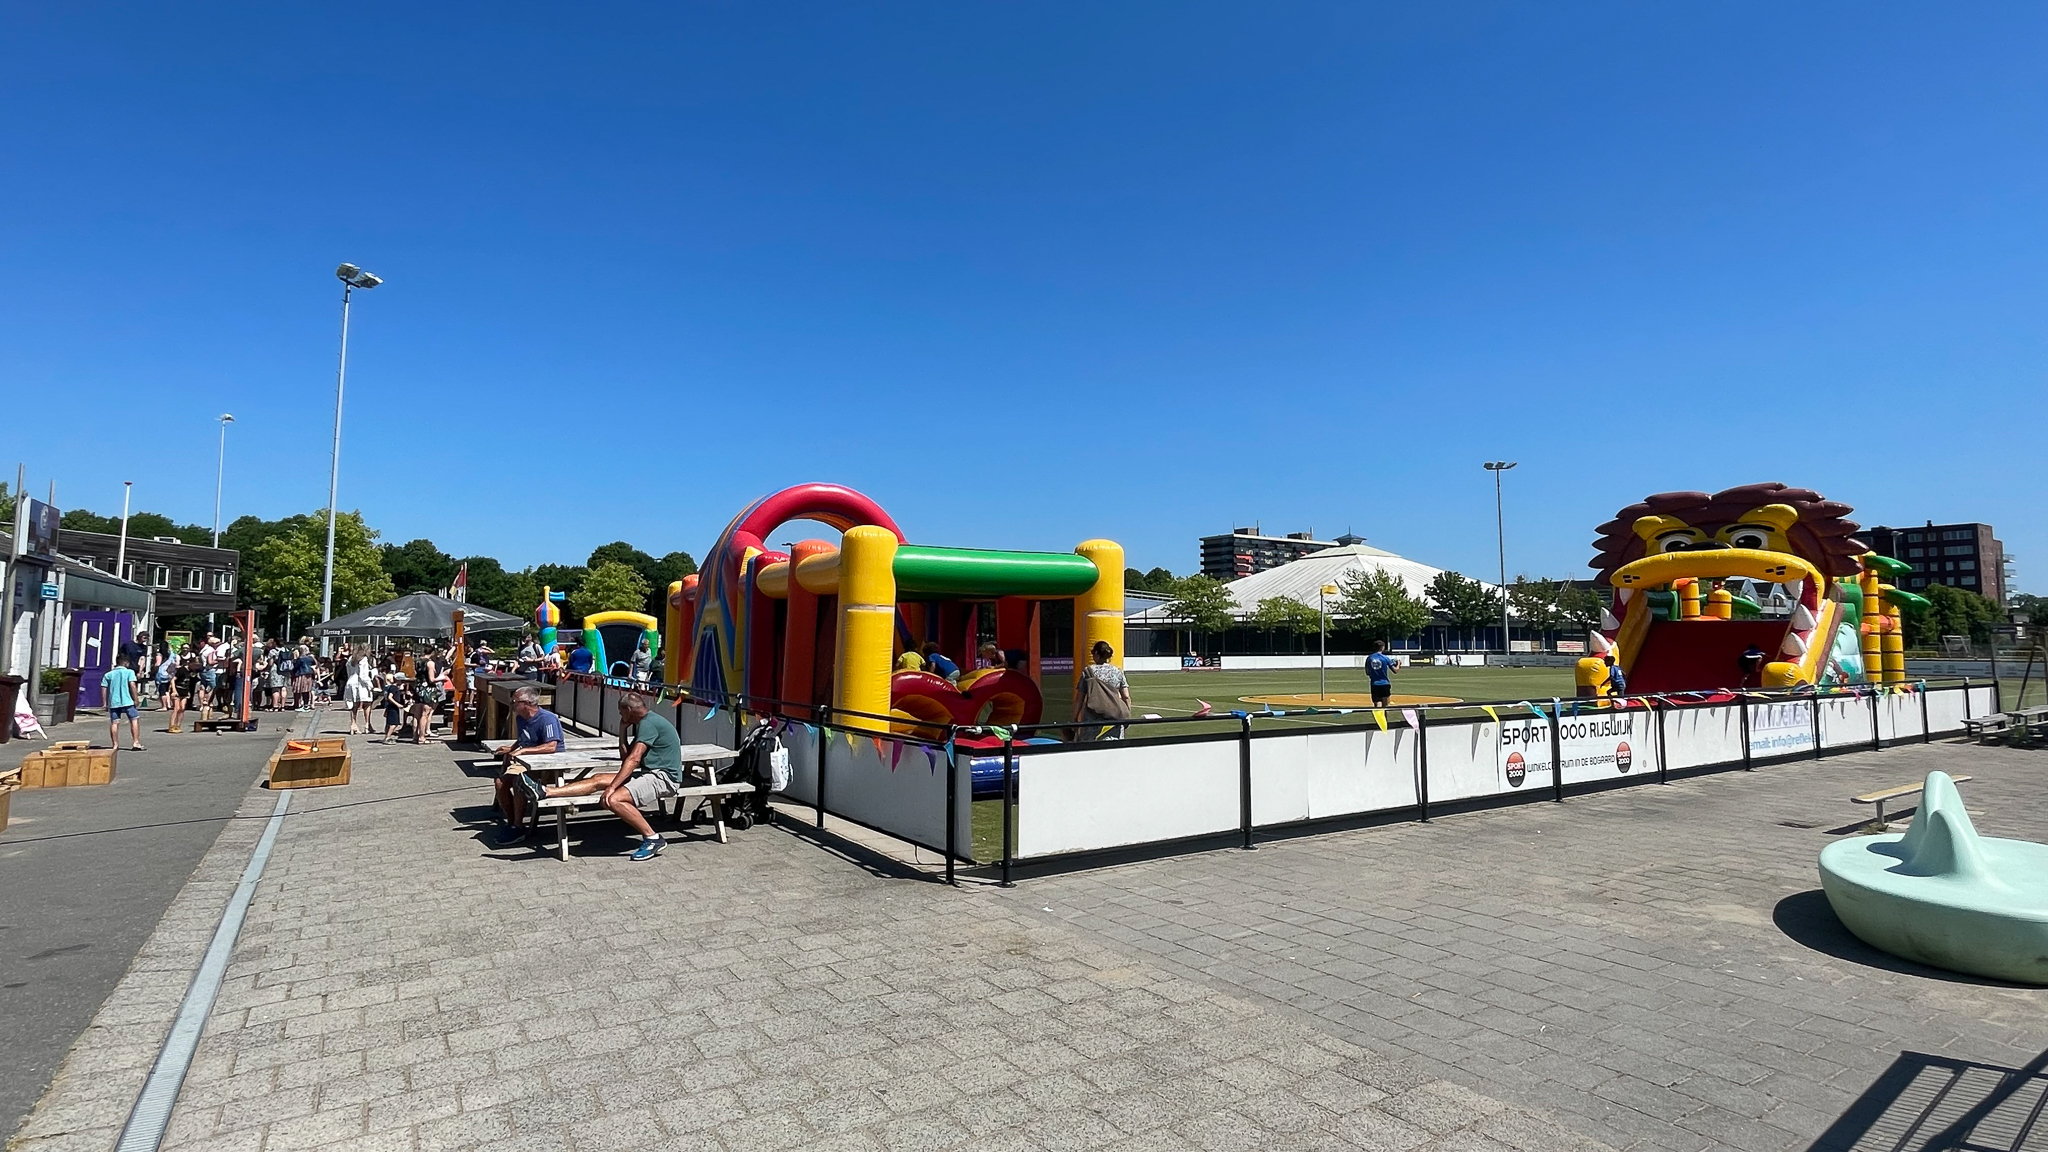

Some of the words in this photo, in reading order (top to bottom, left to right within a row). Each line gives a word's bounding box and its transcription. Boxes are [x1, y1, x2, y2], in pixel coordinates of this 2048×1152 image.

[1502, 726, 1547, 745] SPORT
[1560, 724, 1587, 740] 000
[1590, 719, 1632, 737] RIJSWIJK
[1617, 750, 1630, 758] SPORT
[1507, 761, 1525, 770] SPORT
[1581, 757, 1589, 767] DE
[1589, 755, 1615, 766] BOGAARD
[1618, 757, 1630, 765] 2000
[1508, 769, 1524, 778] 2000
